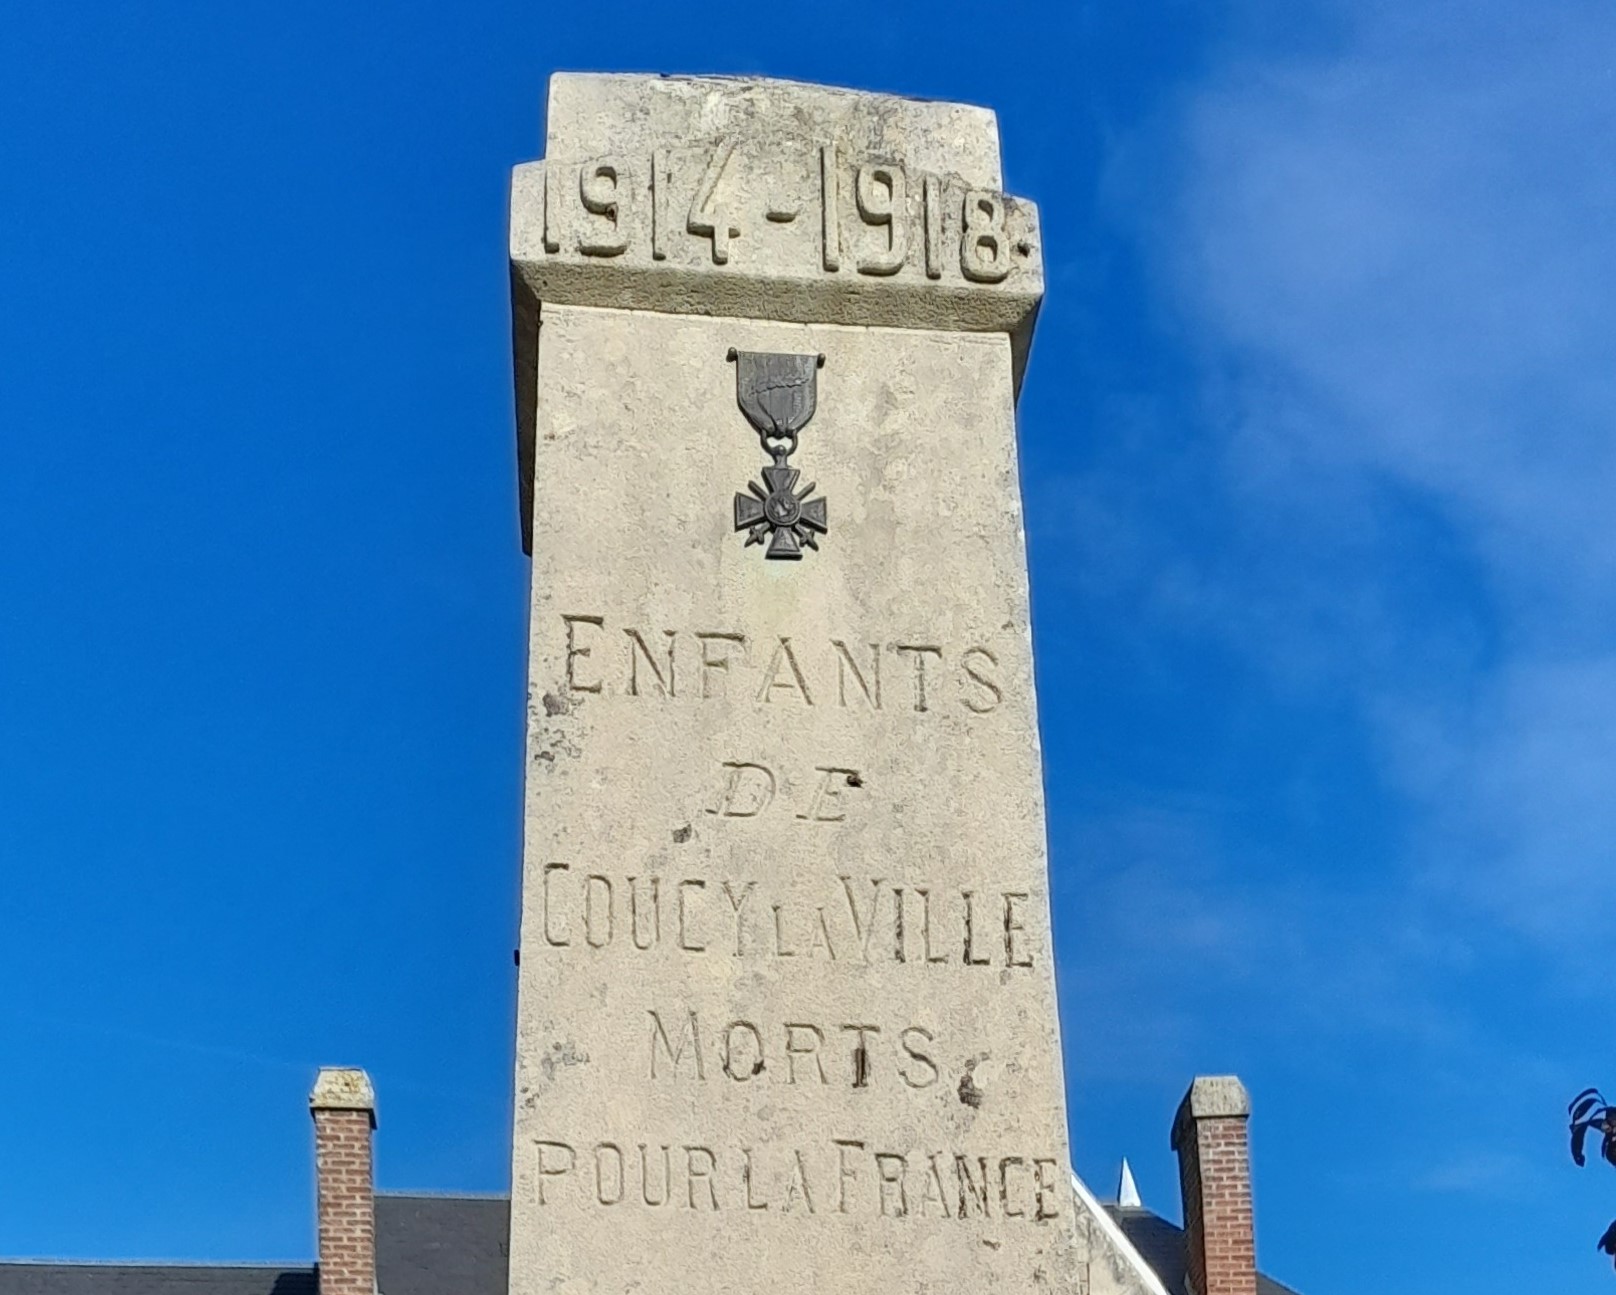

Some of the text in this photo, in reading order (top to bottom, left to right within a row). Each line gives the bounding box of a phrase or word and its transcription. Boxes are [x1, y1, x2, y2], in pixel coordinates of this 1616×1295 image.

[561, 614, 1003, 714] ENFANTS
[705, 761, 865, 822] DE
[543, 863, 1034, 969] COUCY LA VILLE
[646, 1010, 941, 1089] MORTS
[532, 1139, 1061, 1222] POUR LA FRANCE
